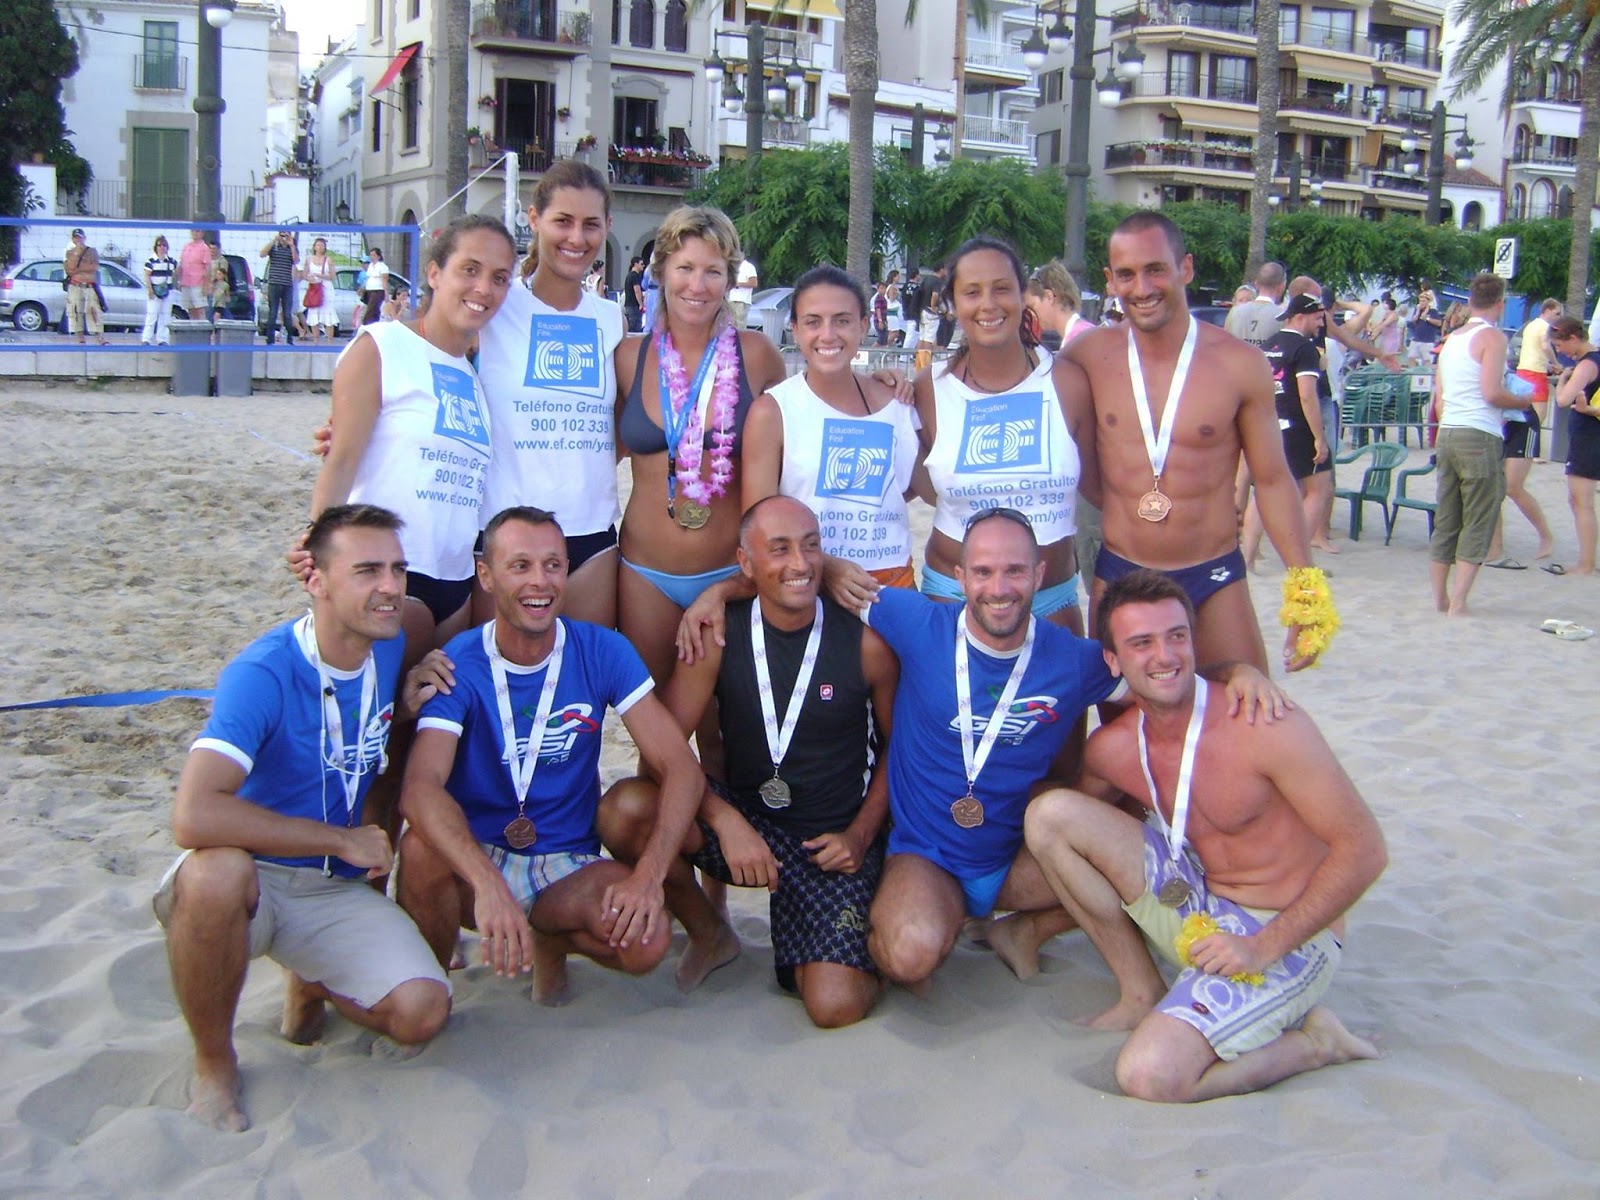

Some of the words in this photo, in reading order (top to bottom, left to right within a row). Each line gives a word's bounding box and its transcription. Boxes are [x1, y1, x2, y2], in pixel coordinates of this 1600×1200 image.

[1251, 320, 1258, 332] 7
[533, 340, 594, 380] EF
[440, 388, 482, 437] EF
[513, 400, 572, 413] Teléfono
[531, 418, 557, 432] 900
[561, 419, 585, 432] 102
[588, 420, 609, 434] 339
[963, 419, 1035, 466] EF
[823, 446, 888, 489] EF
[435, 468, 457, 485] 900
[946, 482, 1014, 498] Teléfono
[1005, 495, 1033, 508] 102
[1039, 492, 1065, 506] 339
[842, 527, 868, 541] 102
